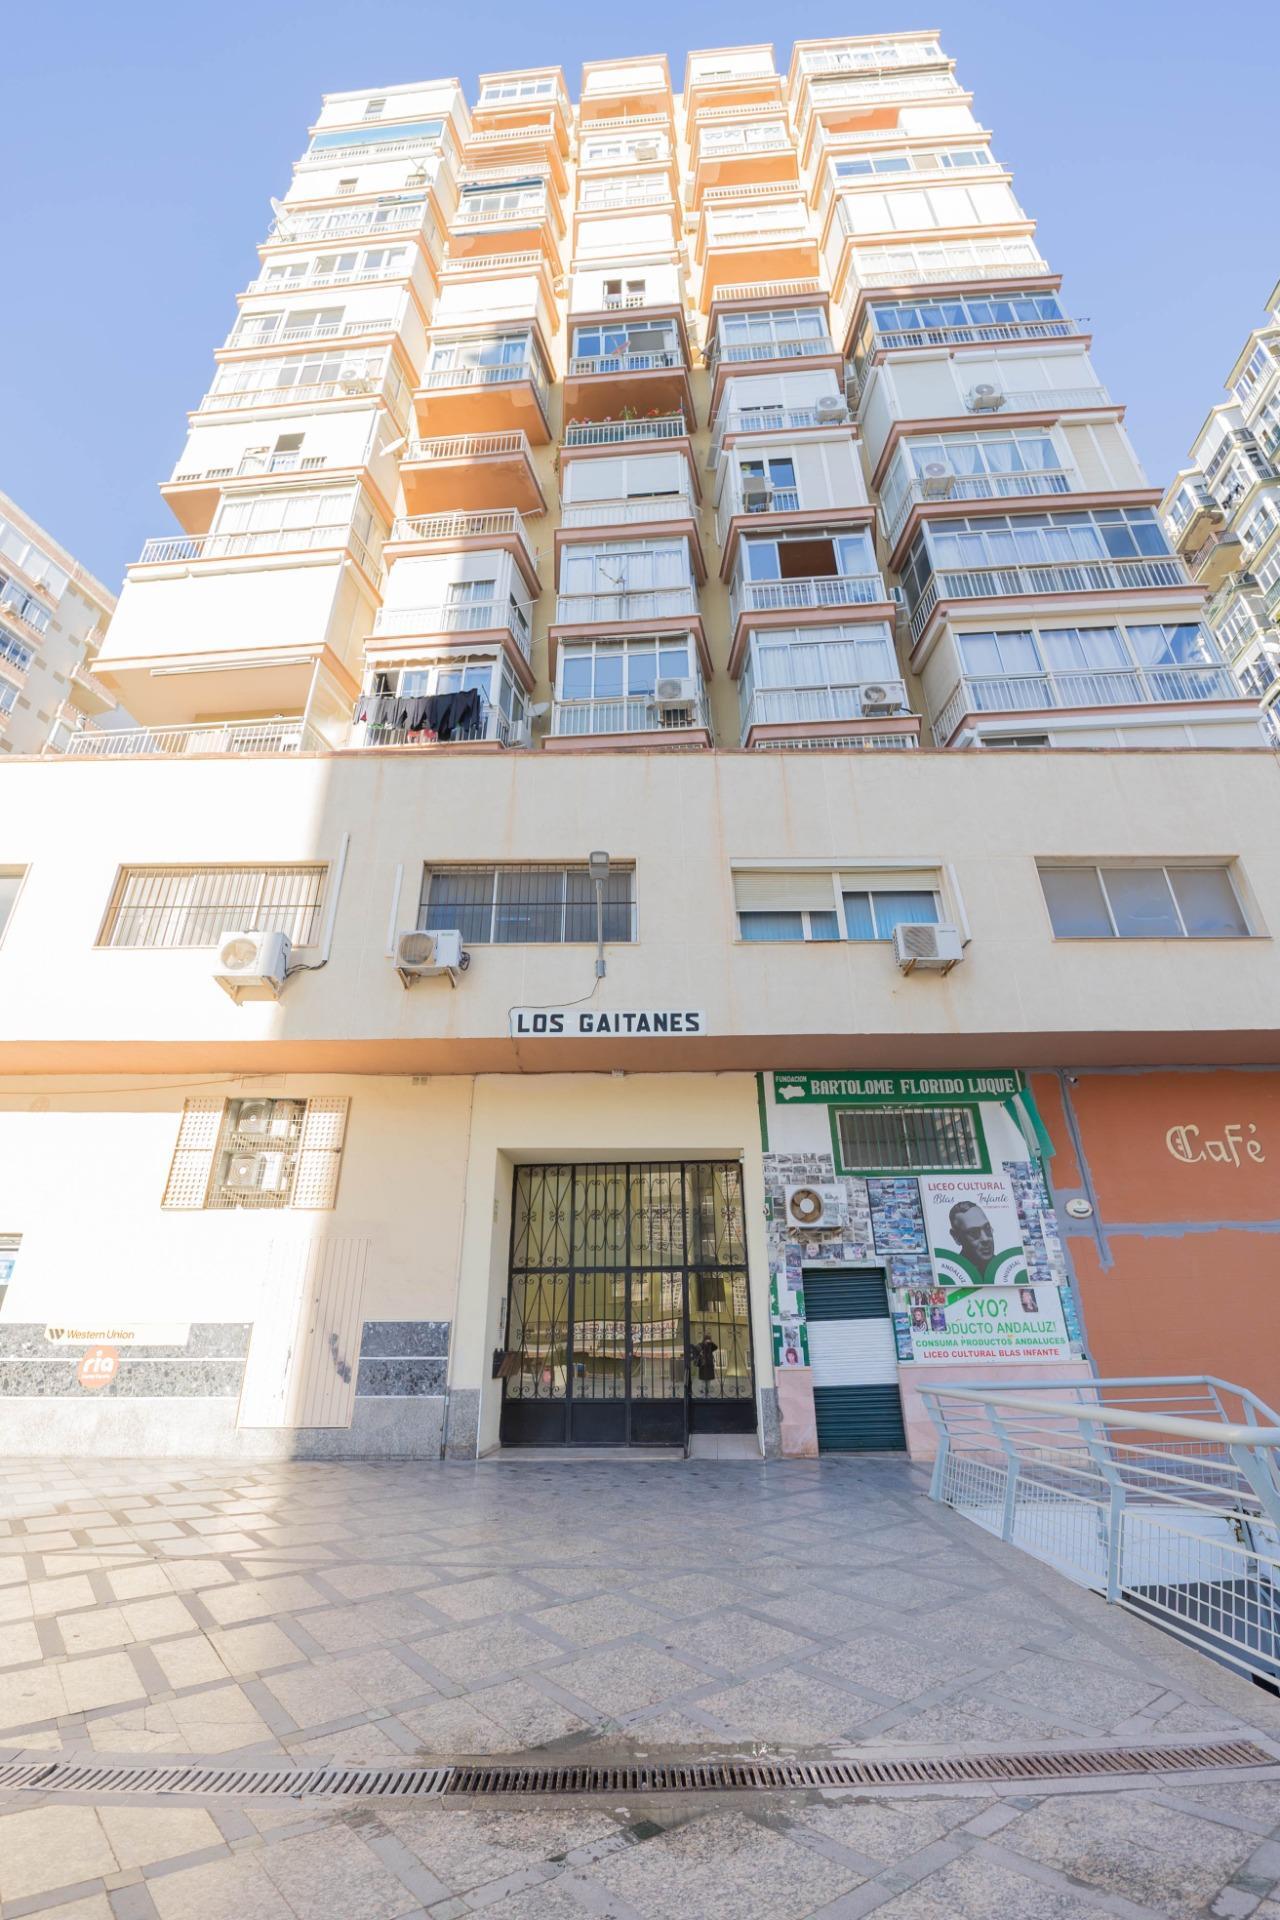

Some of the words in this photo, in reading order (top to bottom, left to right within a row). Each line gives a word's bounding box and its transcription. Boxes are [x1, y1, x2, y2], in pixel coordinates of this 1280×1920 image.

[517, 1013, 564, 1033] LOS
[579, 1012, 700, 1033] GAITANES
[810, 1079, 895, 1095] BARTOLOME
[900, 1078, 965, 1095] FLORIDO
[967, 1077, 1016, 1095] LUQUE
[927, 1182, 956, 1192] LICEO
[956, 1181, 1006, 1191] CULTURAL
[932, 1193, 956, 1205] Blas
[976, 1192, 1010, 1206] Infante
[941, 1263, 967, 1284] ANDALUZ
[966, 1299, 1009, 1318] ¿YO?
[66, 1328, 106, 1340] Western
[106, 1328, 136, 1340] Union
[996, 1320, 1057, 1334] ANDALUZ!
[915, 1339, 959, 1348] CONSUMA
[961, 1338, 1013, 1347] PRODUCTOS
[1015, 1337, 1066, 1346] ANDALUCES
[923, 1350, 950, 1359] LICEO
[951, 1349, 997, 1358] CULTURAL
[998, 1348, 1022, 1357] BLAS
[1023, 1347, 1061, 1357] INFANTE
[82, 1349, 115, 1373] ria
